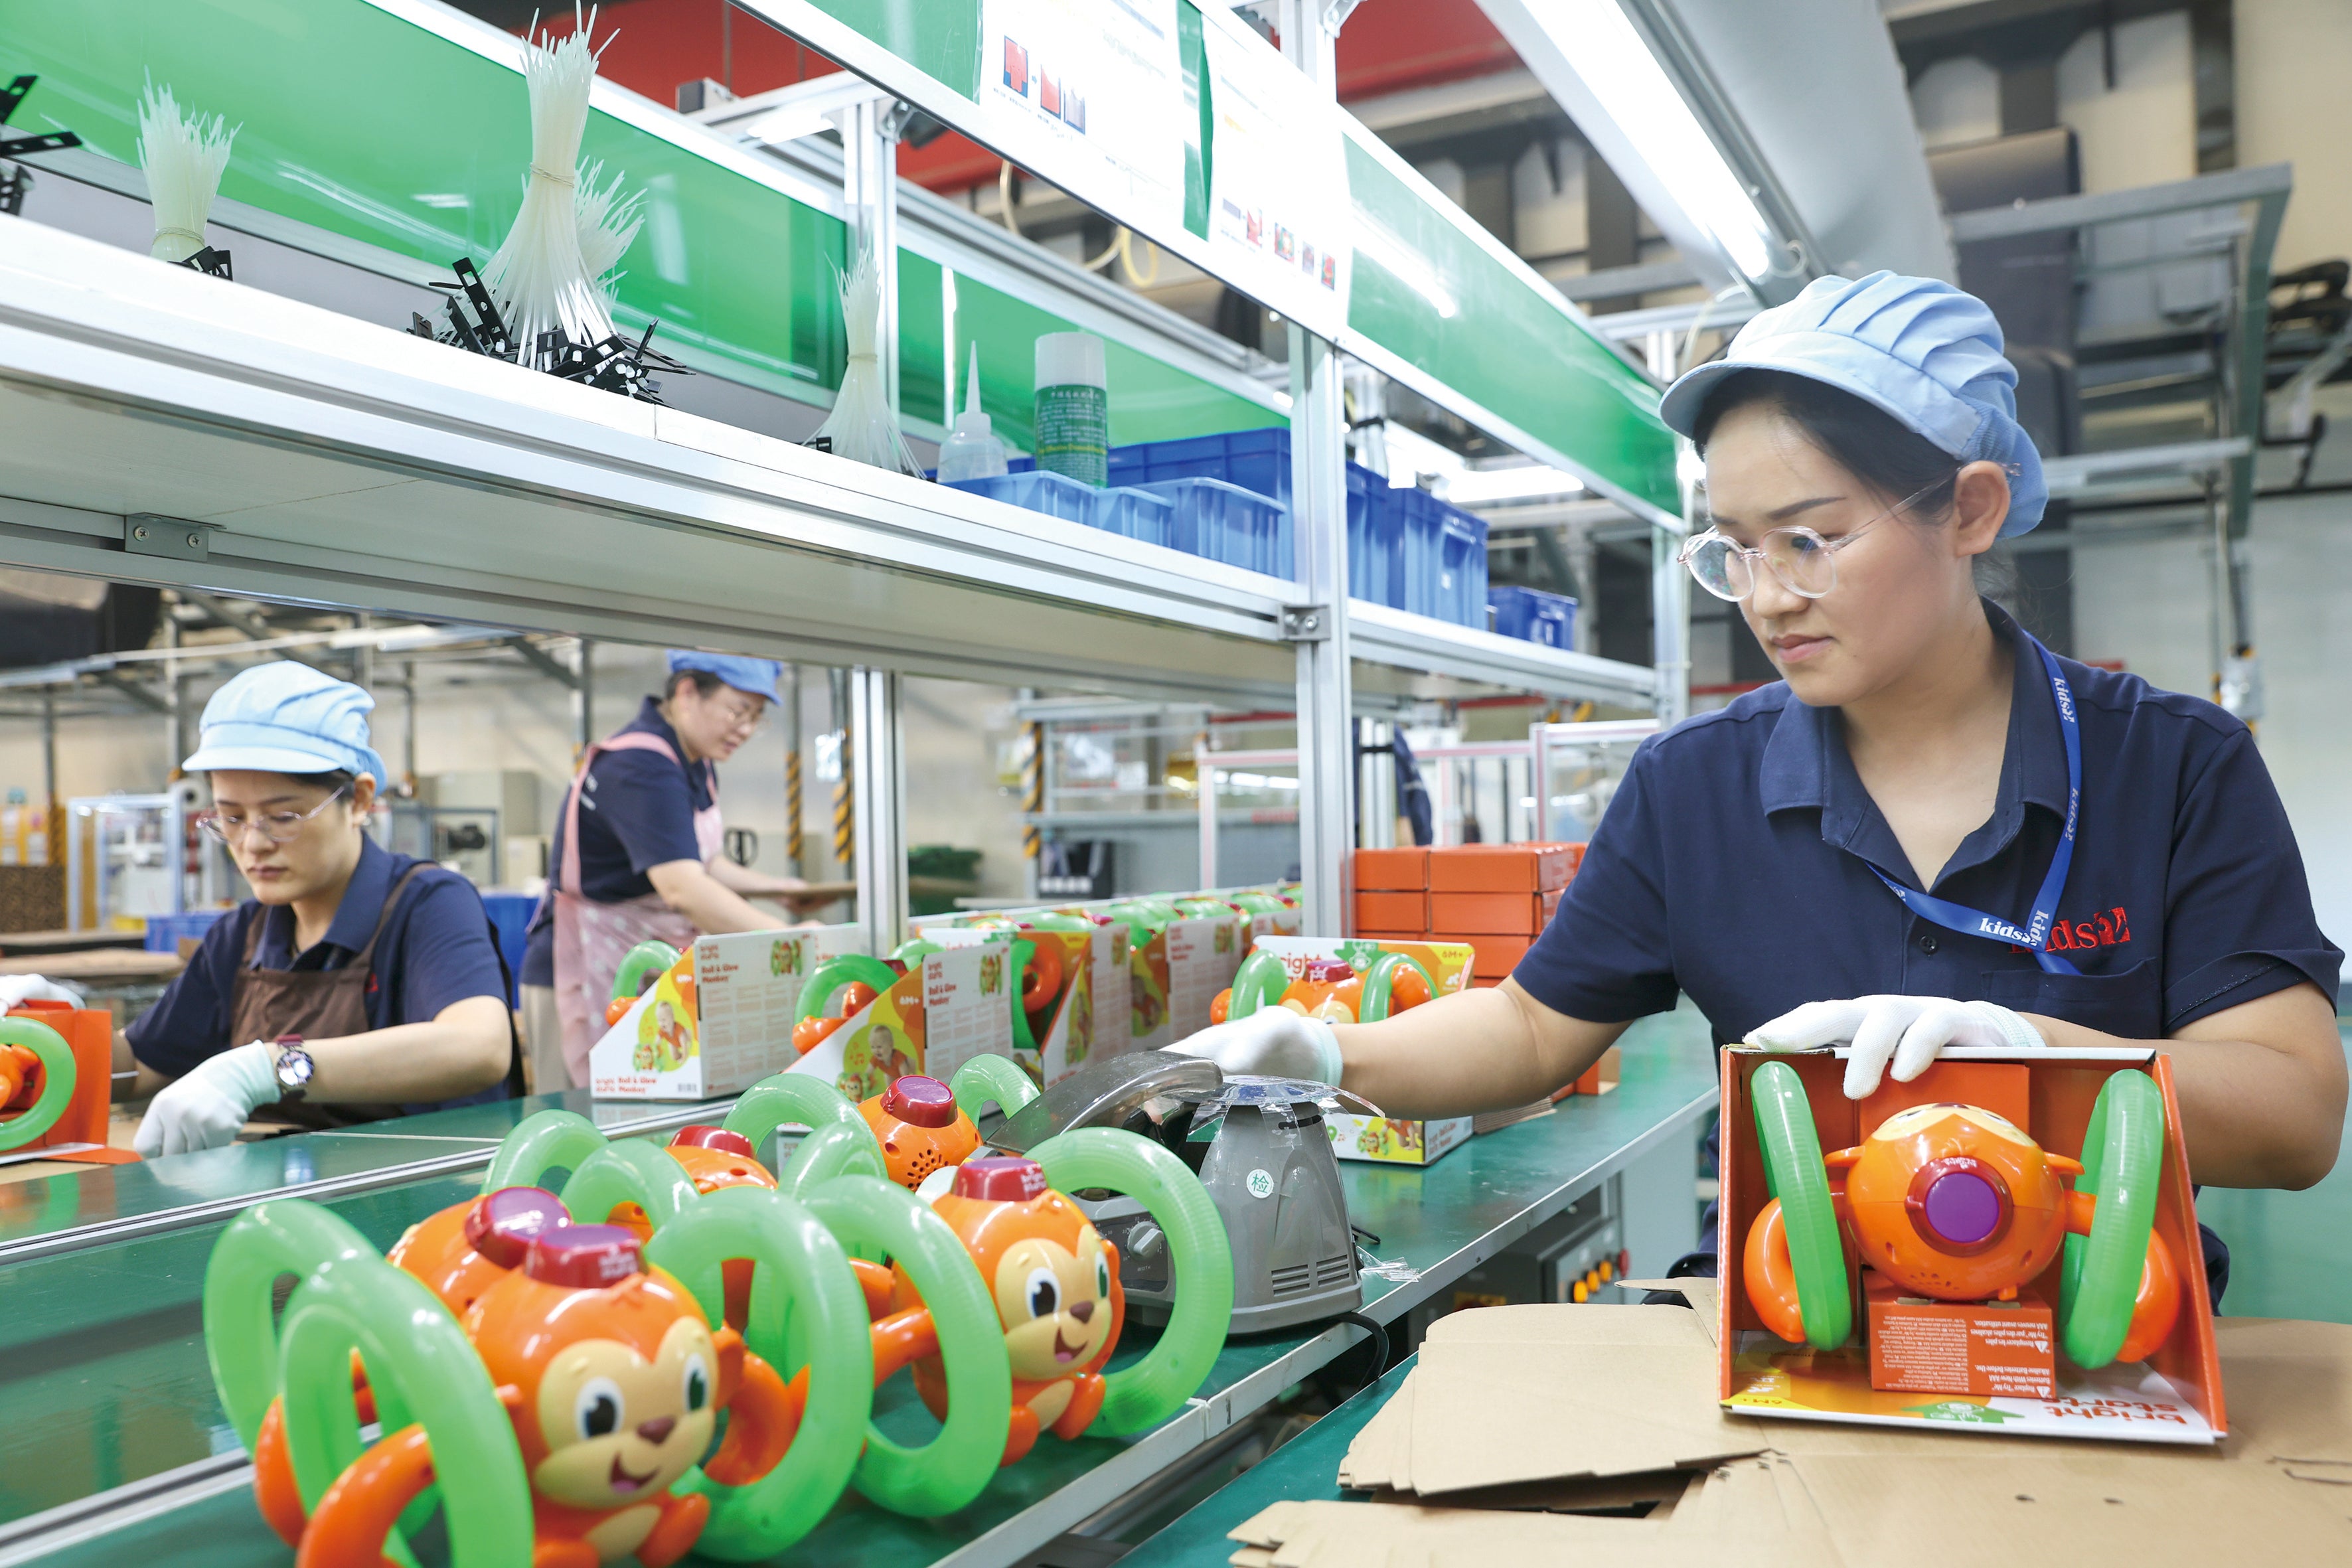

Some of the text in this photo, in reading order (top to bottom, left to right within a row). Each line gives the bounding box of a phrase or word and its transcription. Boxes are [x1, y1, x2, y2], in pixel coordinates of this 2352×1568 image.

[2008, 907, 2131, 953] ds2
[2030, 909, 2049, 942] kid
[1251, 1173, 1269, 1194] 检
[2044, 1407, 2187, 1425] bright
